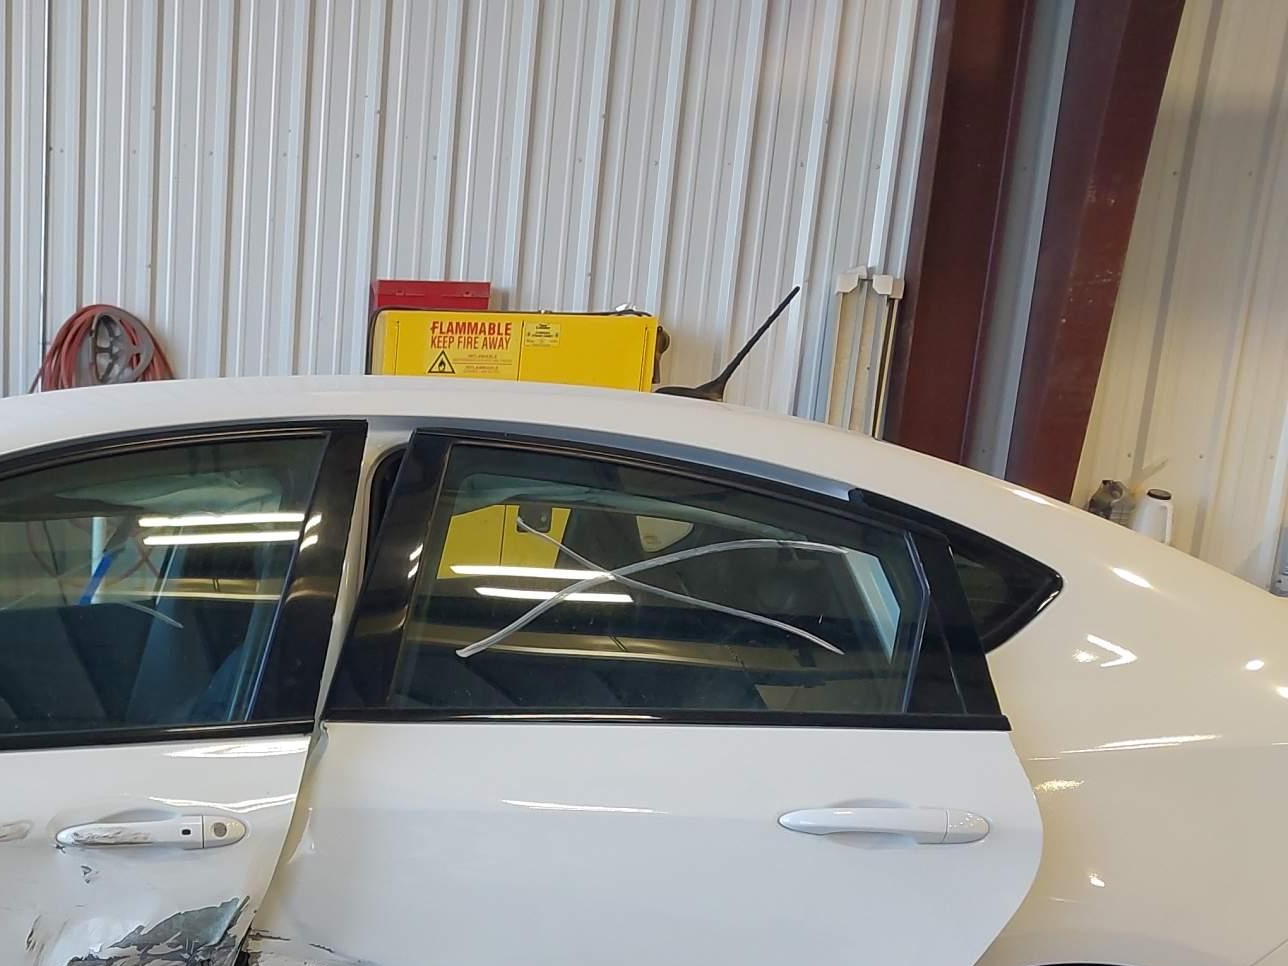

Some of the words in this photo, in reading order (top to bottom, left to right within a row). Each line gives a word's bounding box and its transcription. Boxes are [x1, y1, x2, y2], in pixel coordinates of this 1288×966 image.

[431, 321, 512, 336] FLAMMABLE
[431, 336, 455, 350] KEEP
[457, 336, 480, 350] FIRE
[481, 337, 511, 350] AWAY
